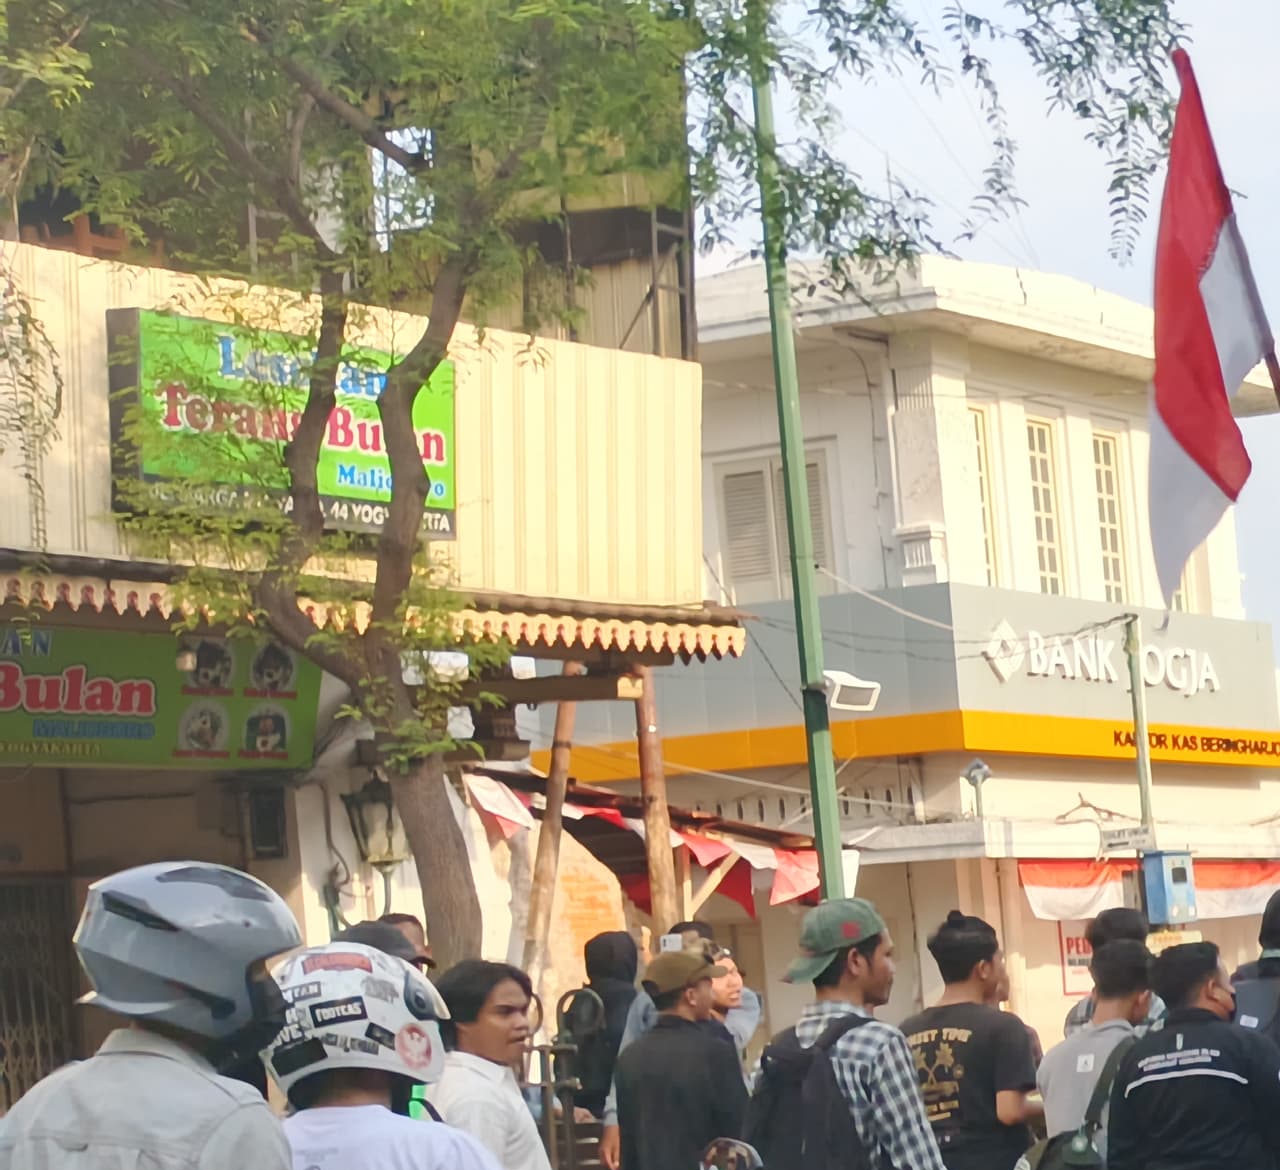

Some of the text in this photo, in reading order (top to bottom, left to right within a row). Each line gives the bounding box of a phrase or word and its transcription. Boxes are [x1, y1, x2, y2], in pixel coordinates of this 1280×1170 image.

[327, 406, 446, 463] Bun
[1027, 631, 1119, 683] BANK
[1172, 733, 1199, 752] KAS
